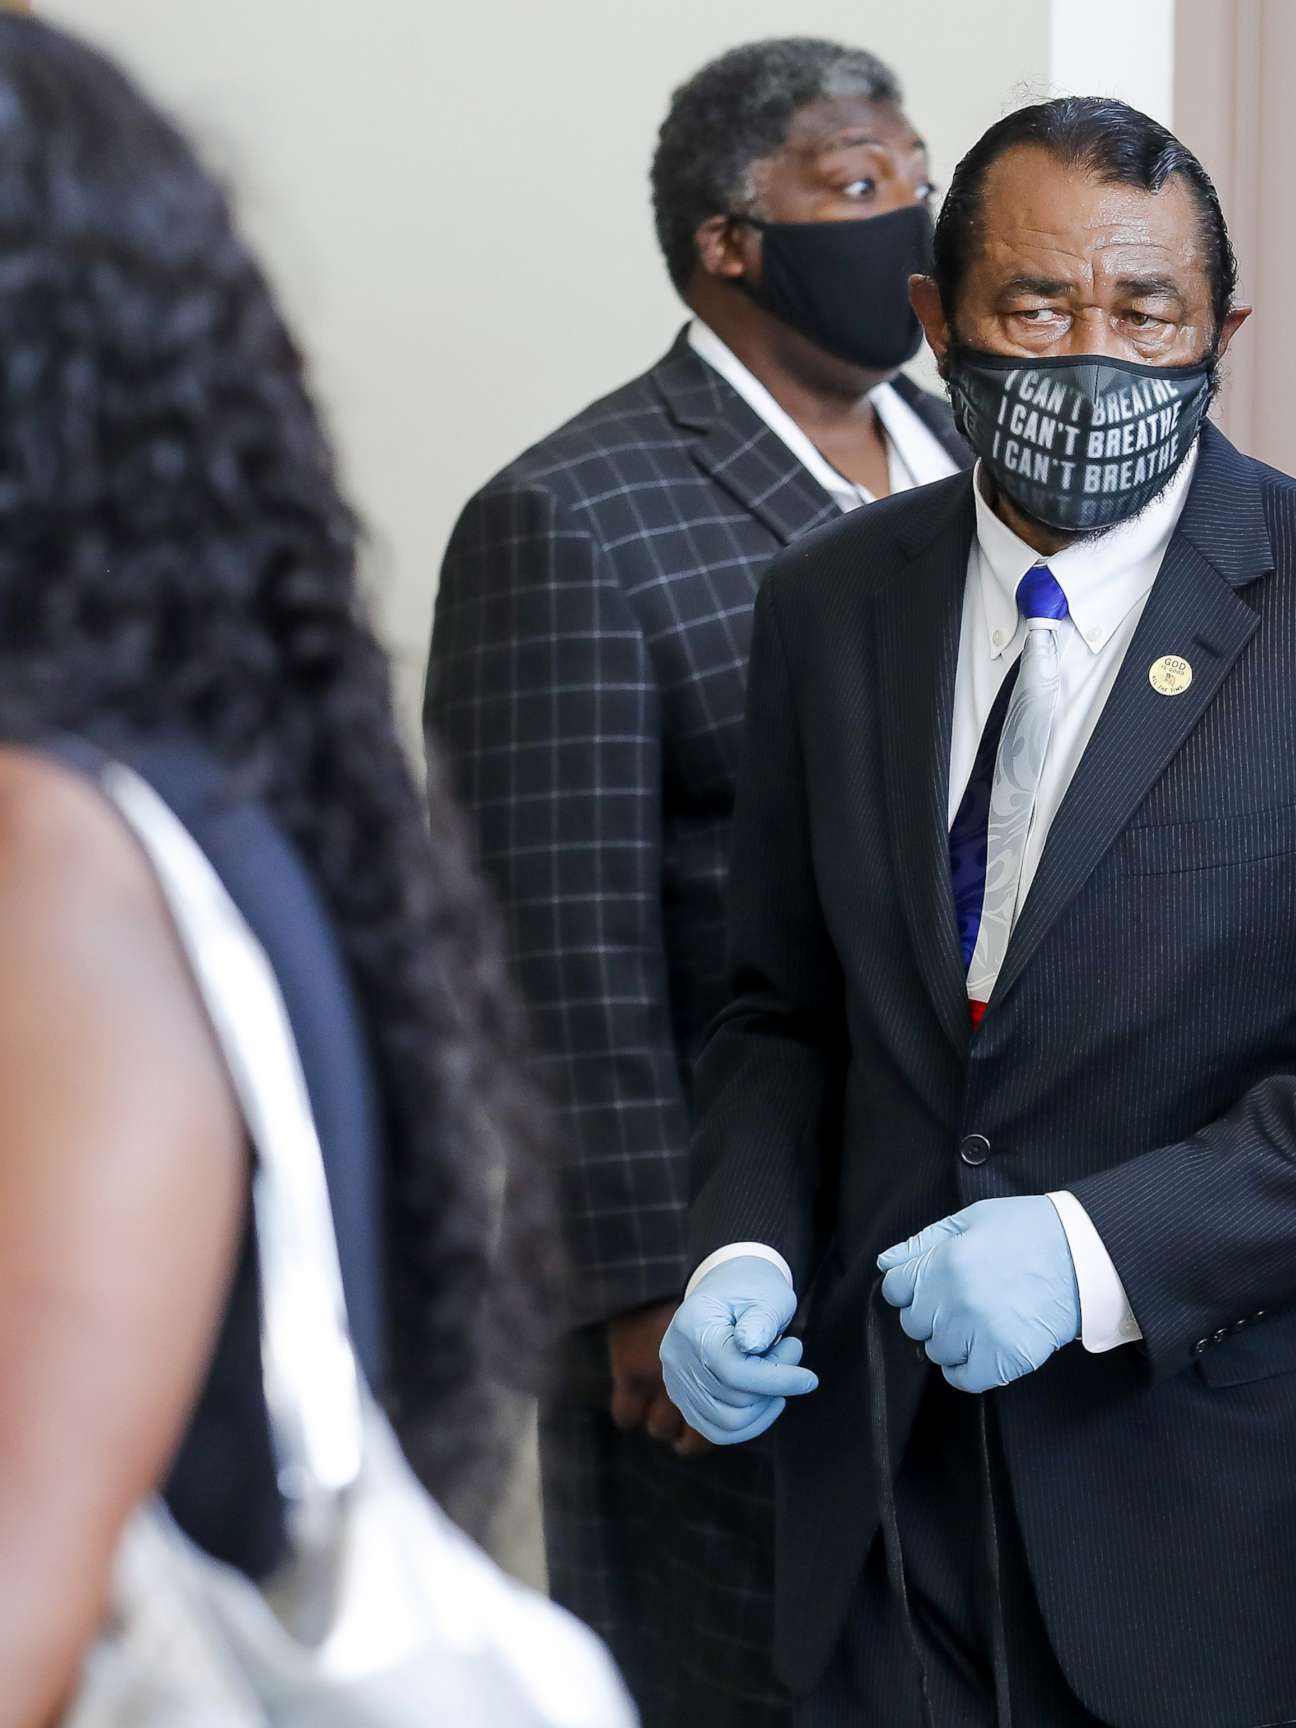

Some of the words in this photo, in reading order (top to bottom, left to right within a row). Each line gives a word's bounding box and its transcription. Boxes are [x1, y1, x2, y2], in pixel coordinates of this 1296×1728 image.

[998, 395, 1007, 424] I
[1010, 404, 1081, 456] CAN'T
[1087, 400, 1183, 459] BREATHE
[992, 430, 1001, 460] I
[1004, 440, 1077, 490] CAN'T
[1083, 433, 1180, 494] BREATHE
[1164, 657, 1186, 670] GOD
